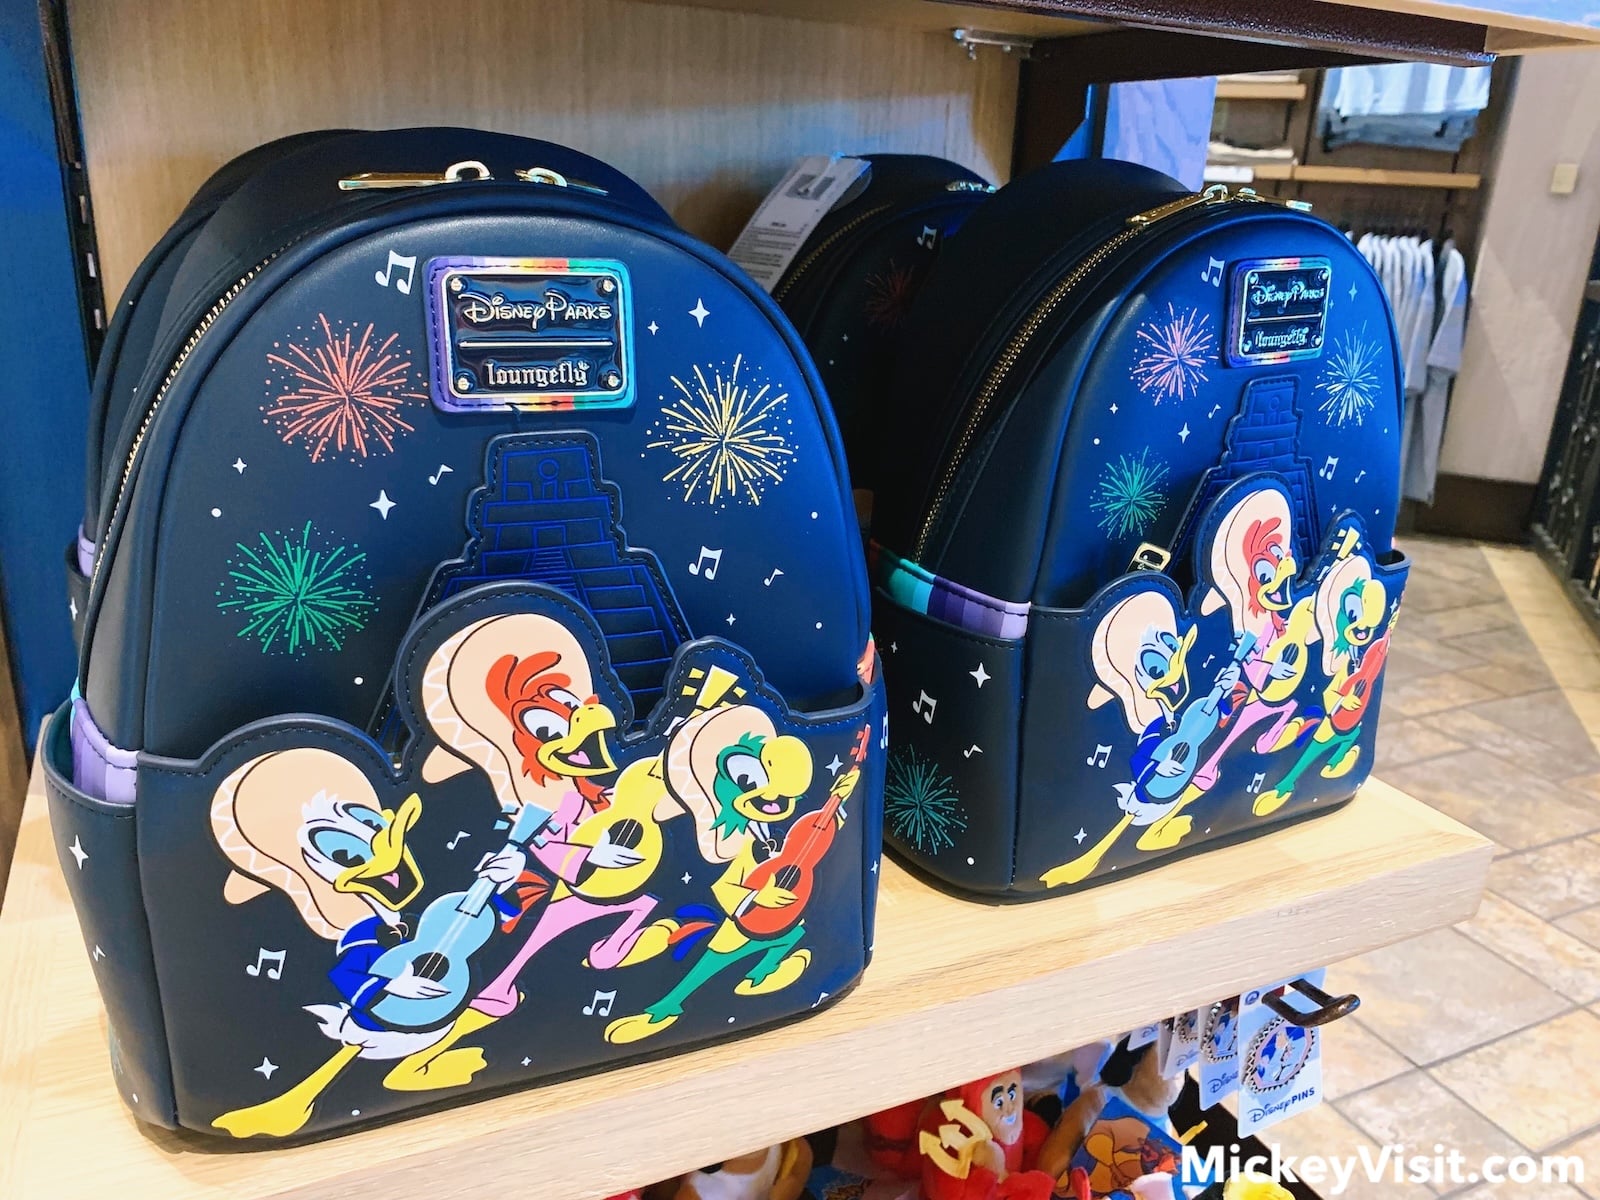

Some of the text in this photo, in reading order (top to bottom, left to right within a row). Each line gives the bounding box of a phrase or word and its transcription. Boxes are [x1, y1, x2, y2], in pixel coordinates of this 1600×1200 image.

[458, 290, 612, 330] Disney Parks
[486, 361, 590, 388] loungefly
[1247, 1086, 1315, 1123] Disney PINS
